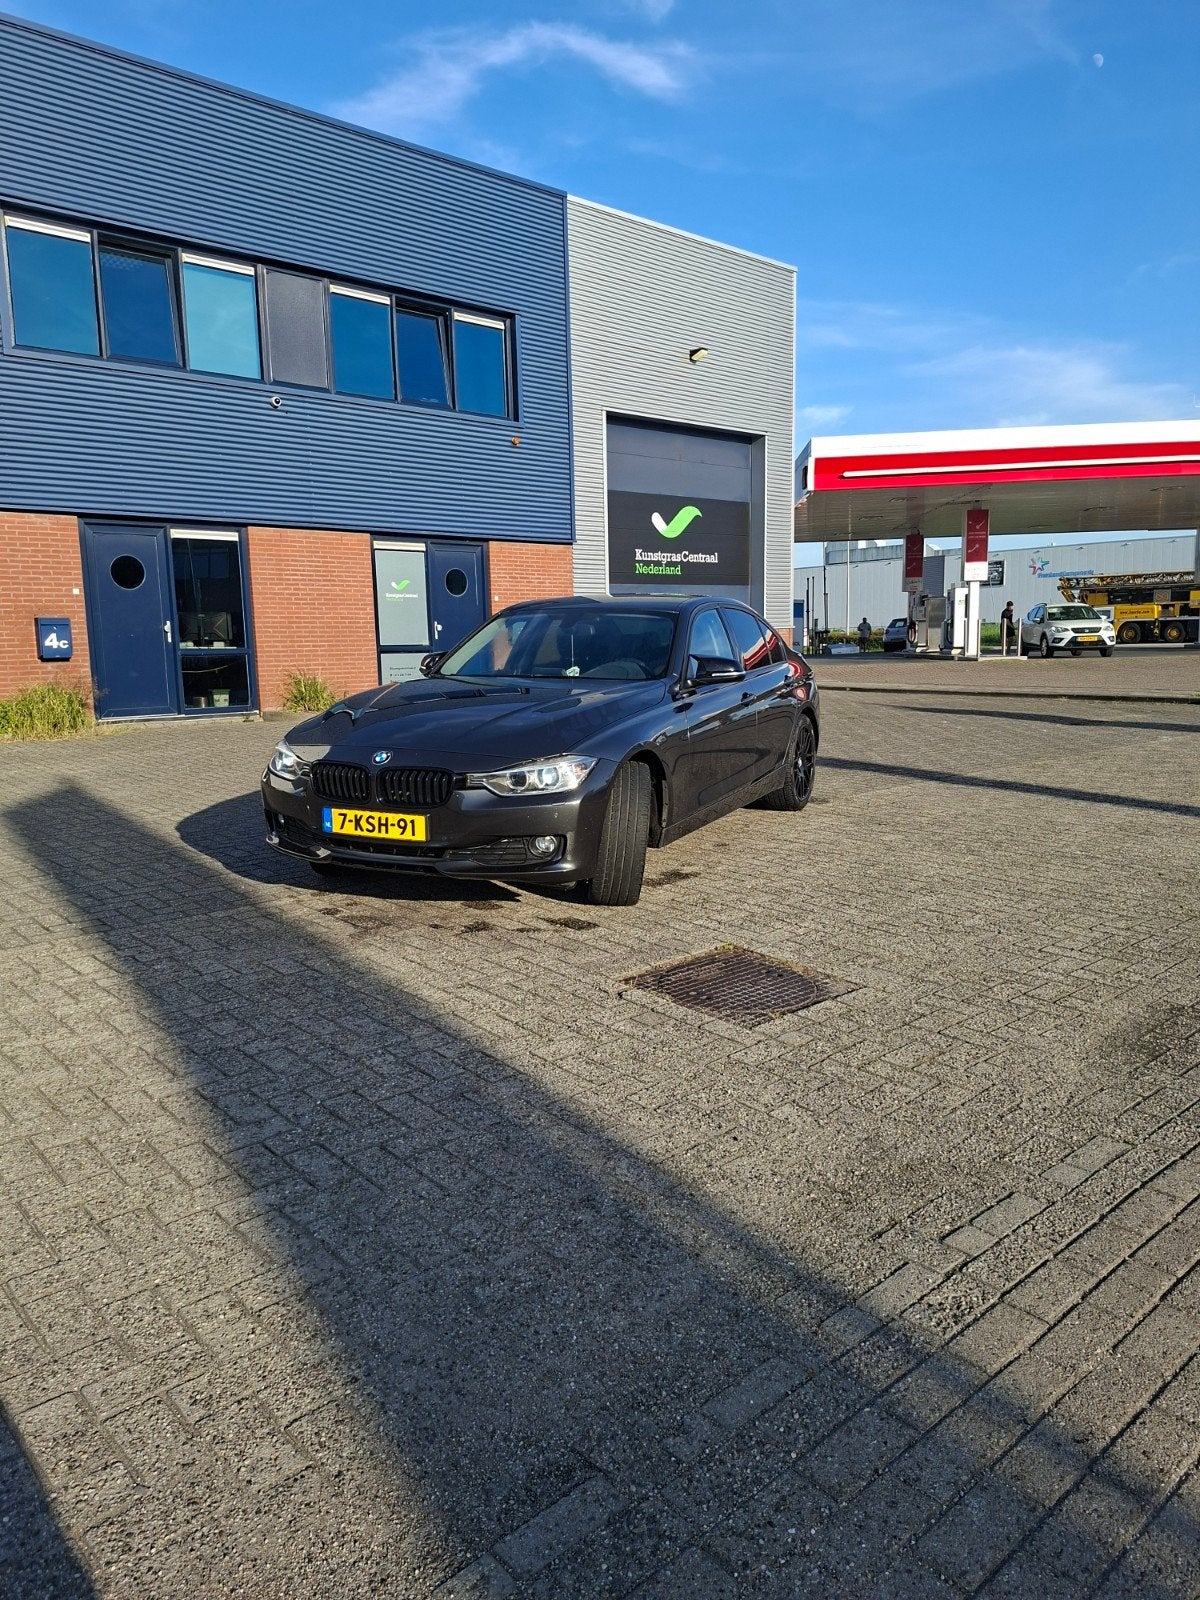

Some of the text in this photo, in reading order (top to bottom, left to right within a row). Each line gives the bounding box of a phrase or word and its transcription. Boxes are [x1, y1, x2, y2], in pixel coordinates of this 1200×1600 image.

[634, 548, 719, 564] KunstgrasCentraal
[635, 563, 682, 575] Nederland
[338, 812, 416, 837] 7-KSH-91
